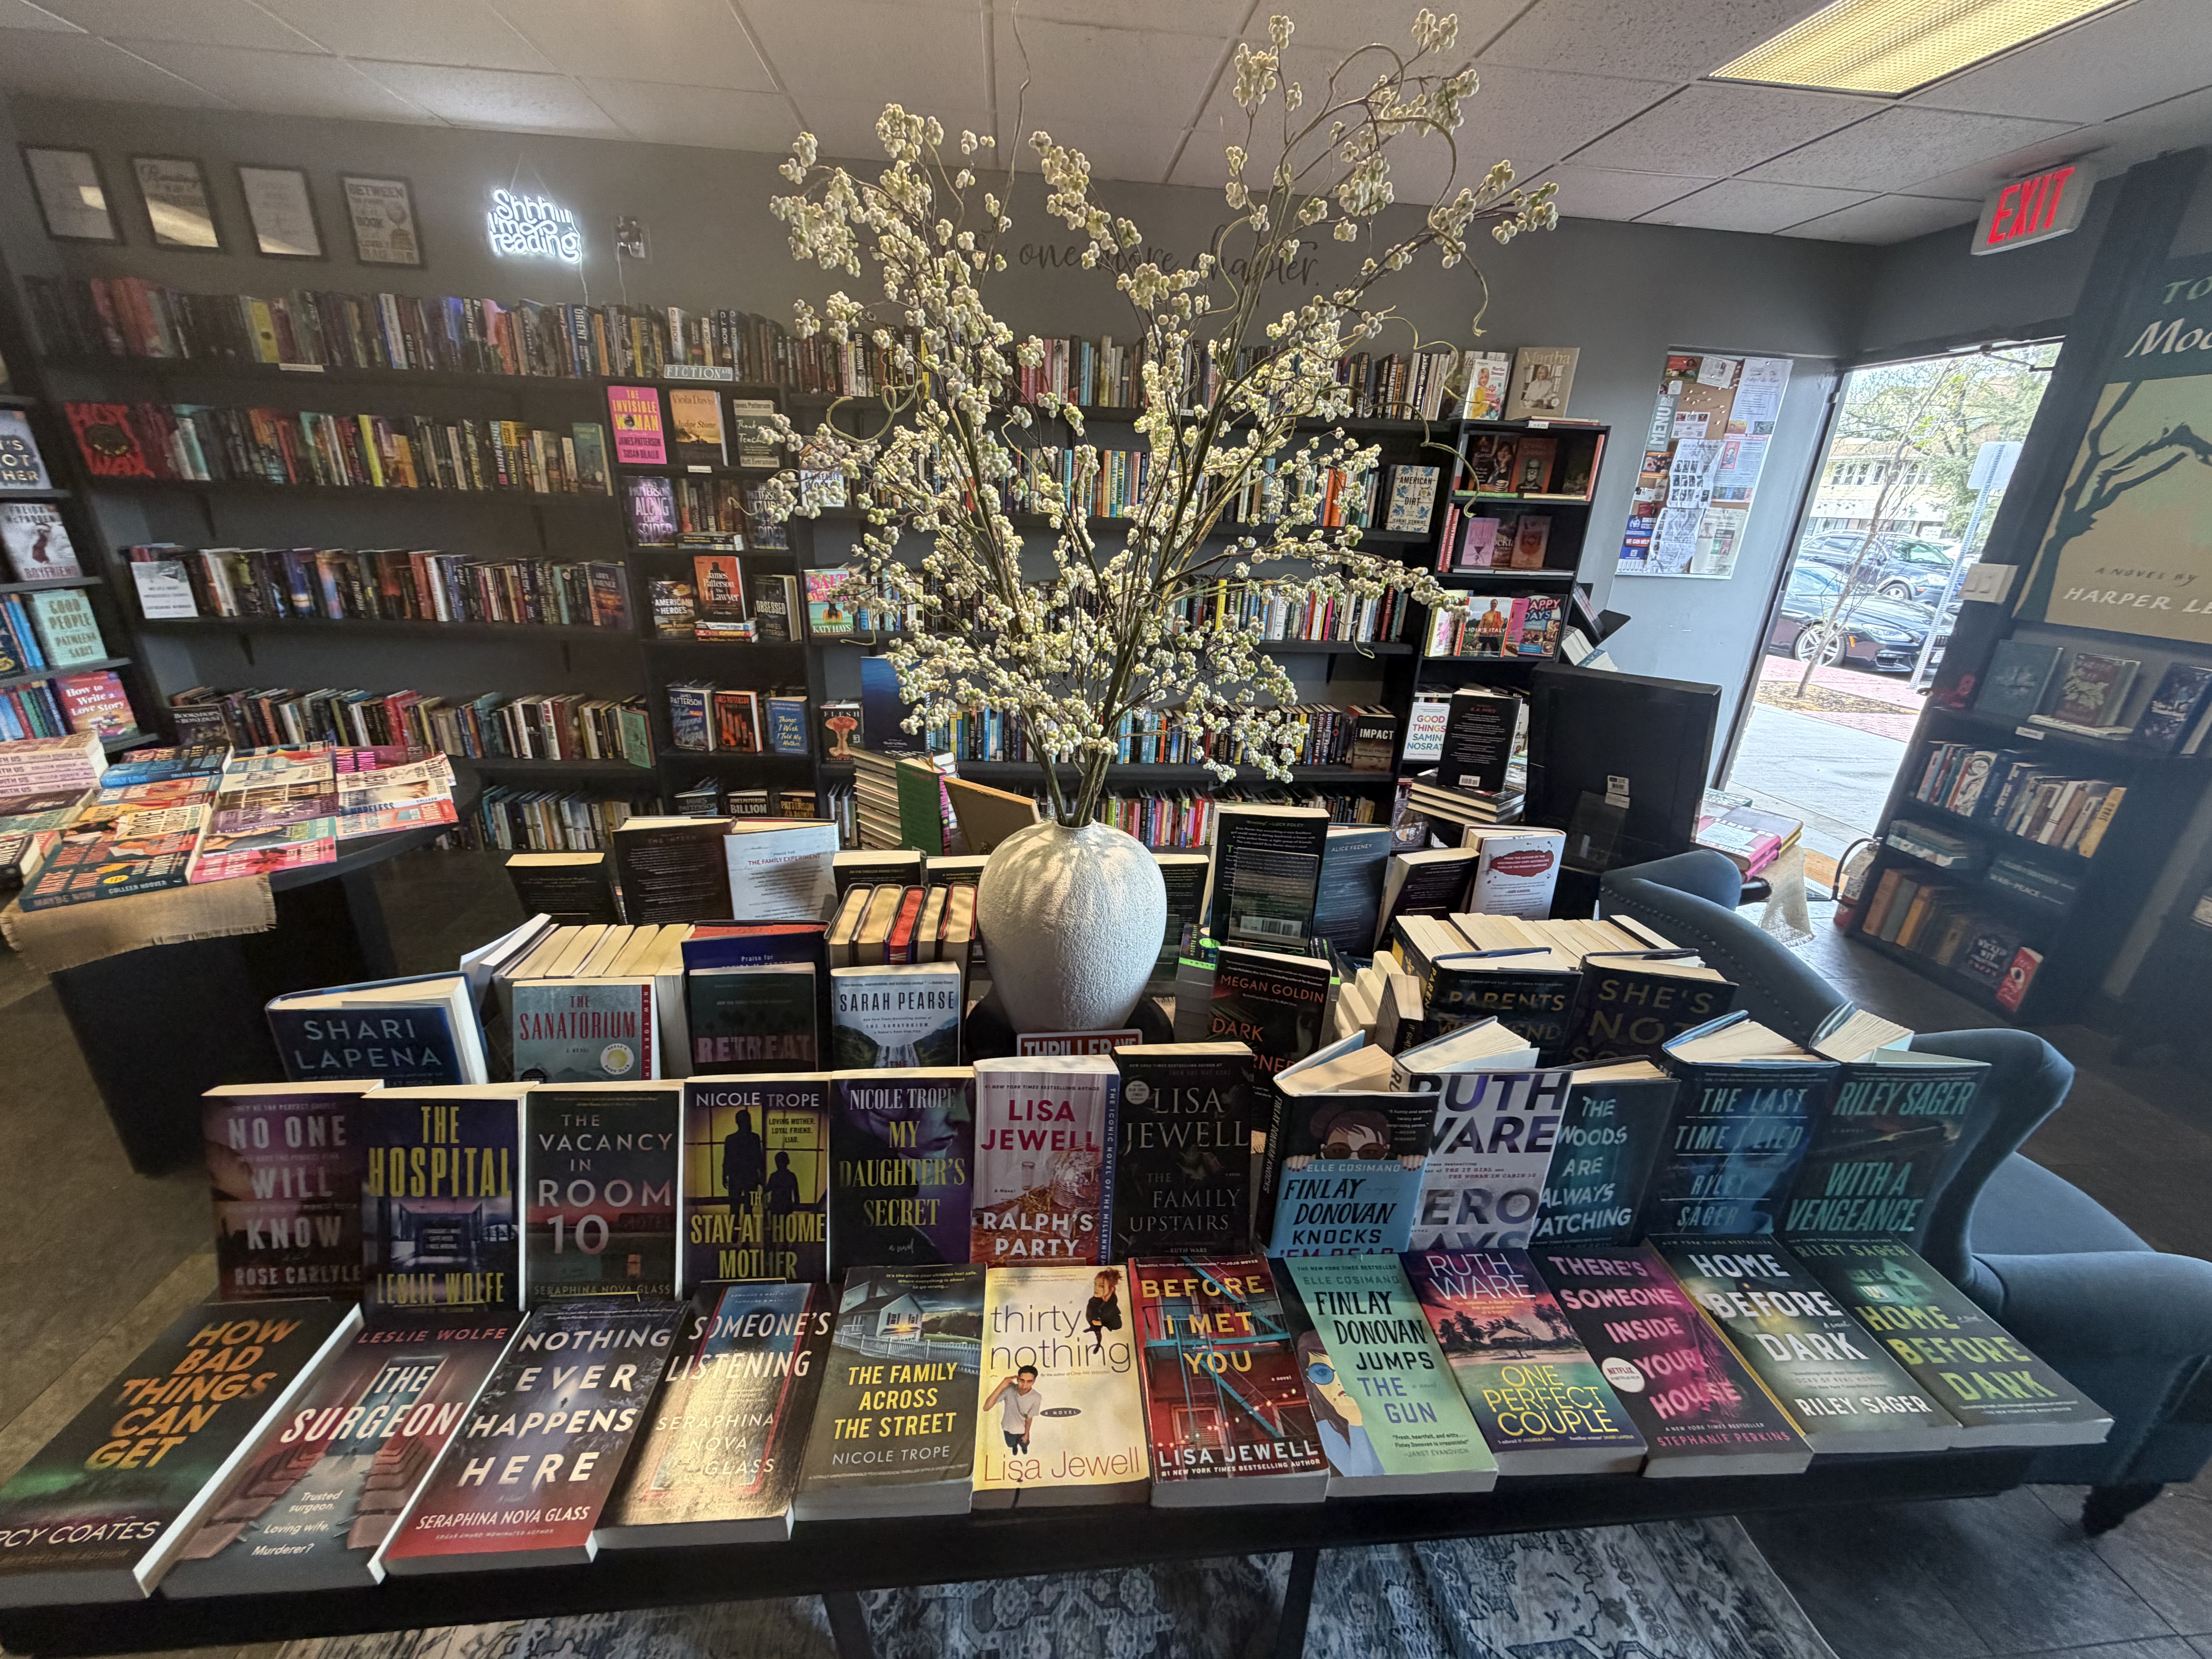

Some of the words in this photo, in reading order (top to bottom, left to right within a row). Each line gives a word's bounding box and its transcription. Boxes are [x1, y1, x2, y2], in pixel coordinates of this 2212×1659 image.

[1987, 166, 2075, 245] EXIT
[489, 231, 579, 262] reading
[1019, 242, 1080, 268] one
[1524, 352, 1570, 364] Martha
[667, 366, 721, 378] FICTION
[626, 390, 639, 400] THE
[672, 395, 691, 404] Viola
[692, 396, 715, 404] Davis
[612, 399, 657, 414] INVISIBLE
[678, 420, 696, 429] Judge
[1649, 404, 1671, 445] MENU
[634, 438, 661, 447] PATTERSON
[623, 449, 640, 458] SUSAN
[3, 470, 40, 481] HER
[1399, 476, 1432, 485] AMERICAN
[635, 498, 669, 516] ALONG
[1404, 497, 1420, 506] DIRT
[703, 579, 734, 588] Patterson
[708, 570, 728, 579] James
[2110, 568, 2166, 580] NOVEL
[2173, 574, 2200, 587] BY
[48, 599, 81, 614] GOOD
[655, 599, 694, 608] AMERICAN
[711, 594, 739, 604] Lawyer
[756, 601, 787, 615] OBSESSED
[2063, 588, 2171, 610] HARPER
[48, 613, 92, 629] PEOPLE
[812, 625, 832, 634] KATY
[833, 624, 852, 633] HAYS
[66, 685, 91, 697] How
[77, 693, 106, 705] Write
[71, 703, 96, 716] Love
[97, 701, 125, 713] Story
[670, 698, 702, 706] PATTERSON
[778, 716, 797, 724] Things
[1416, 714, 1446, 724] GOOD
[1360, 728, 1394, 740] IMPACT
[1412, 724, 1446, 733] THINGS
[1412, 733, 1442, 742] SAMIN
[350, 802, 395, 814] HOPELESS
[730, 804, 767, 814] BILLION
[1331, 845, 1349, 853] ALICE
[1351, 843, 1373, 851] FEENEY
[761, 856, 782, 865] FAMILY
[783, 853, 821, 863] EXPERIMENT
[140, 879, 167, 889] HOOVER
[1221, 975, 1269, 991] MEGAN
[1272, 984, 1324, 1004] GOLDIN
[570, 996, 589, 1008] THE
[840, 992, 891, 1012] SARAH
[898, 991, 955, 1011] PEARSE
[304, 1018, 416, 1041] SHARI
[519, 1011, 636, 1041] SANATORIUM
[295, 1046, 442, 1070] LAPENA
[696, 1092, 761, 1108] NICOLE
[767, 1094, 820, 1107] TROPE
[1008, 1099, 1075, 1122] LISA
[421, 1106, 460, 1145] THE
[562, 1114, 601, 1127] THE
[538, 1133, 674, 1151] VACANCY
[368, 1147, 512, 1199] HOSPITAL
[570, 1159, 591, 1172] IN
[1307, 1164, 1335, 1173] ELLE
[1338, 1164, 1401, 1172] COSIMANO
[1147, 1172, 1172, 1183] THE
[538, 1180, 672, 1208] ROOM
[1292, 1230, 1381, 1245] KNOCKS
[995, 1238, 1080, 1256] PARTY
[1426, 1253, 1514, 1278] RUTH
[1688, 1254, 1792, 1278] HOME
[1304, 1276, 1332, 1285] ELLE
[1338, 1275, 1400, 1285] COSIMANO
[1429, 1275, 1536, 1301] WARE
[1314, 1291, 1393, 1316] FINLAY
[1559, 1288, 1682, 1310] SOMEONE
[688, 1312, 832, 1341] SOMEONE'S
[1167, 1314, 1174, 1335] I
[1190, 1312, 1252, 1334] MET
[1334, 1319, 1429, 1345] DONOVAN
[1604, 1317, 1685, 1344] INSIDE
[358, 1330, 428, 1344] LESLIE
[437, 1328, 508, 1341] WOLFE
[517, 1324, 672, 1353] NOTHING
[1755, 1333, 1870, 1362] DARK
[1355, 1352, 1435, 1371] JUMPS
[374, 1365, 436, 1393] THE
[515, 1364, 638, 1393] EVER
[848, 1365, 884, 1385] THE
[890, 1362, 958, 1384] FAMILY
[1501, 1365, 1565, 1388] ONE
[1357, 1377, 1407, 1397] THE
[859, 1388, 938, 1411] ACROSS
[1482, 1387, 1606, 1412] PERFECT
[110, 1404, 223, 1437] CAN
[1384, 1402, 1438, 1424] GUN
[280, 1402, 464, 1443] SURGEON
[466, 1407, 639, 1440] HAPPENS
[834, 1417, 872, 1440] THE
[879, 1412, 957, 1438] STREET
[1497, 1409, 1619, 1437] COUPLE
[687, 1437, 747, 1451] NOVA
[1656, 1433, 1732, 1447] STEPHANIE
[1734, 1431, 1791, 1444] PERKINS
[832, 1450, 893, 1465] NICOLE
[901, 1446, 950, 1460] TROPE
[984, 1454, 1042, 1482] Lisa
[1051, 1446, 1140, 1478] Jewell
[416, 1511, 498, 1530] SERAPHINA
[500, 1509, 541, 1524] NOVA
[544, 1506, 591, 1522] GLASS
